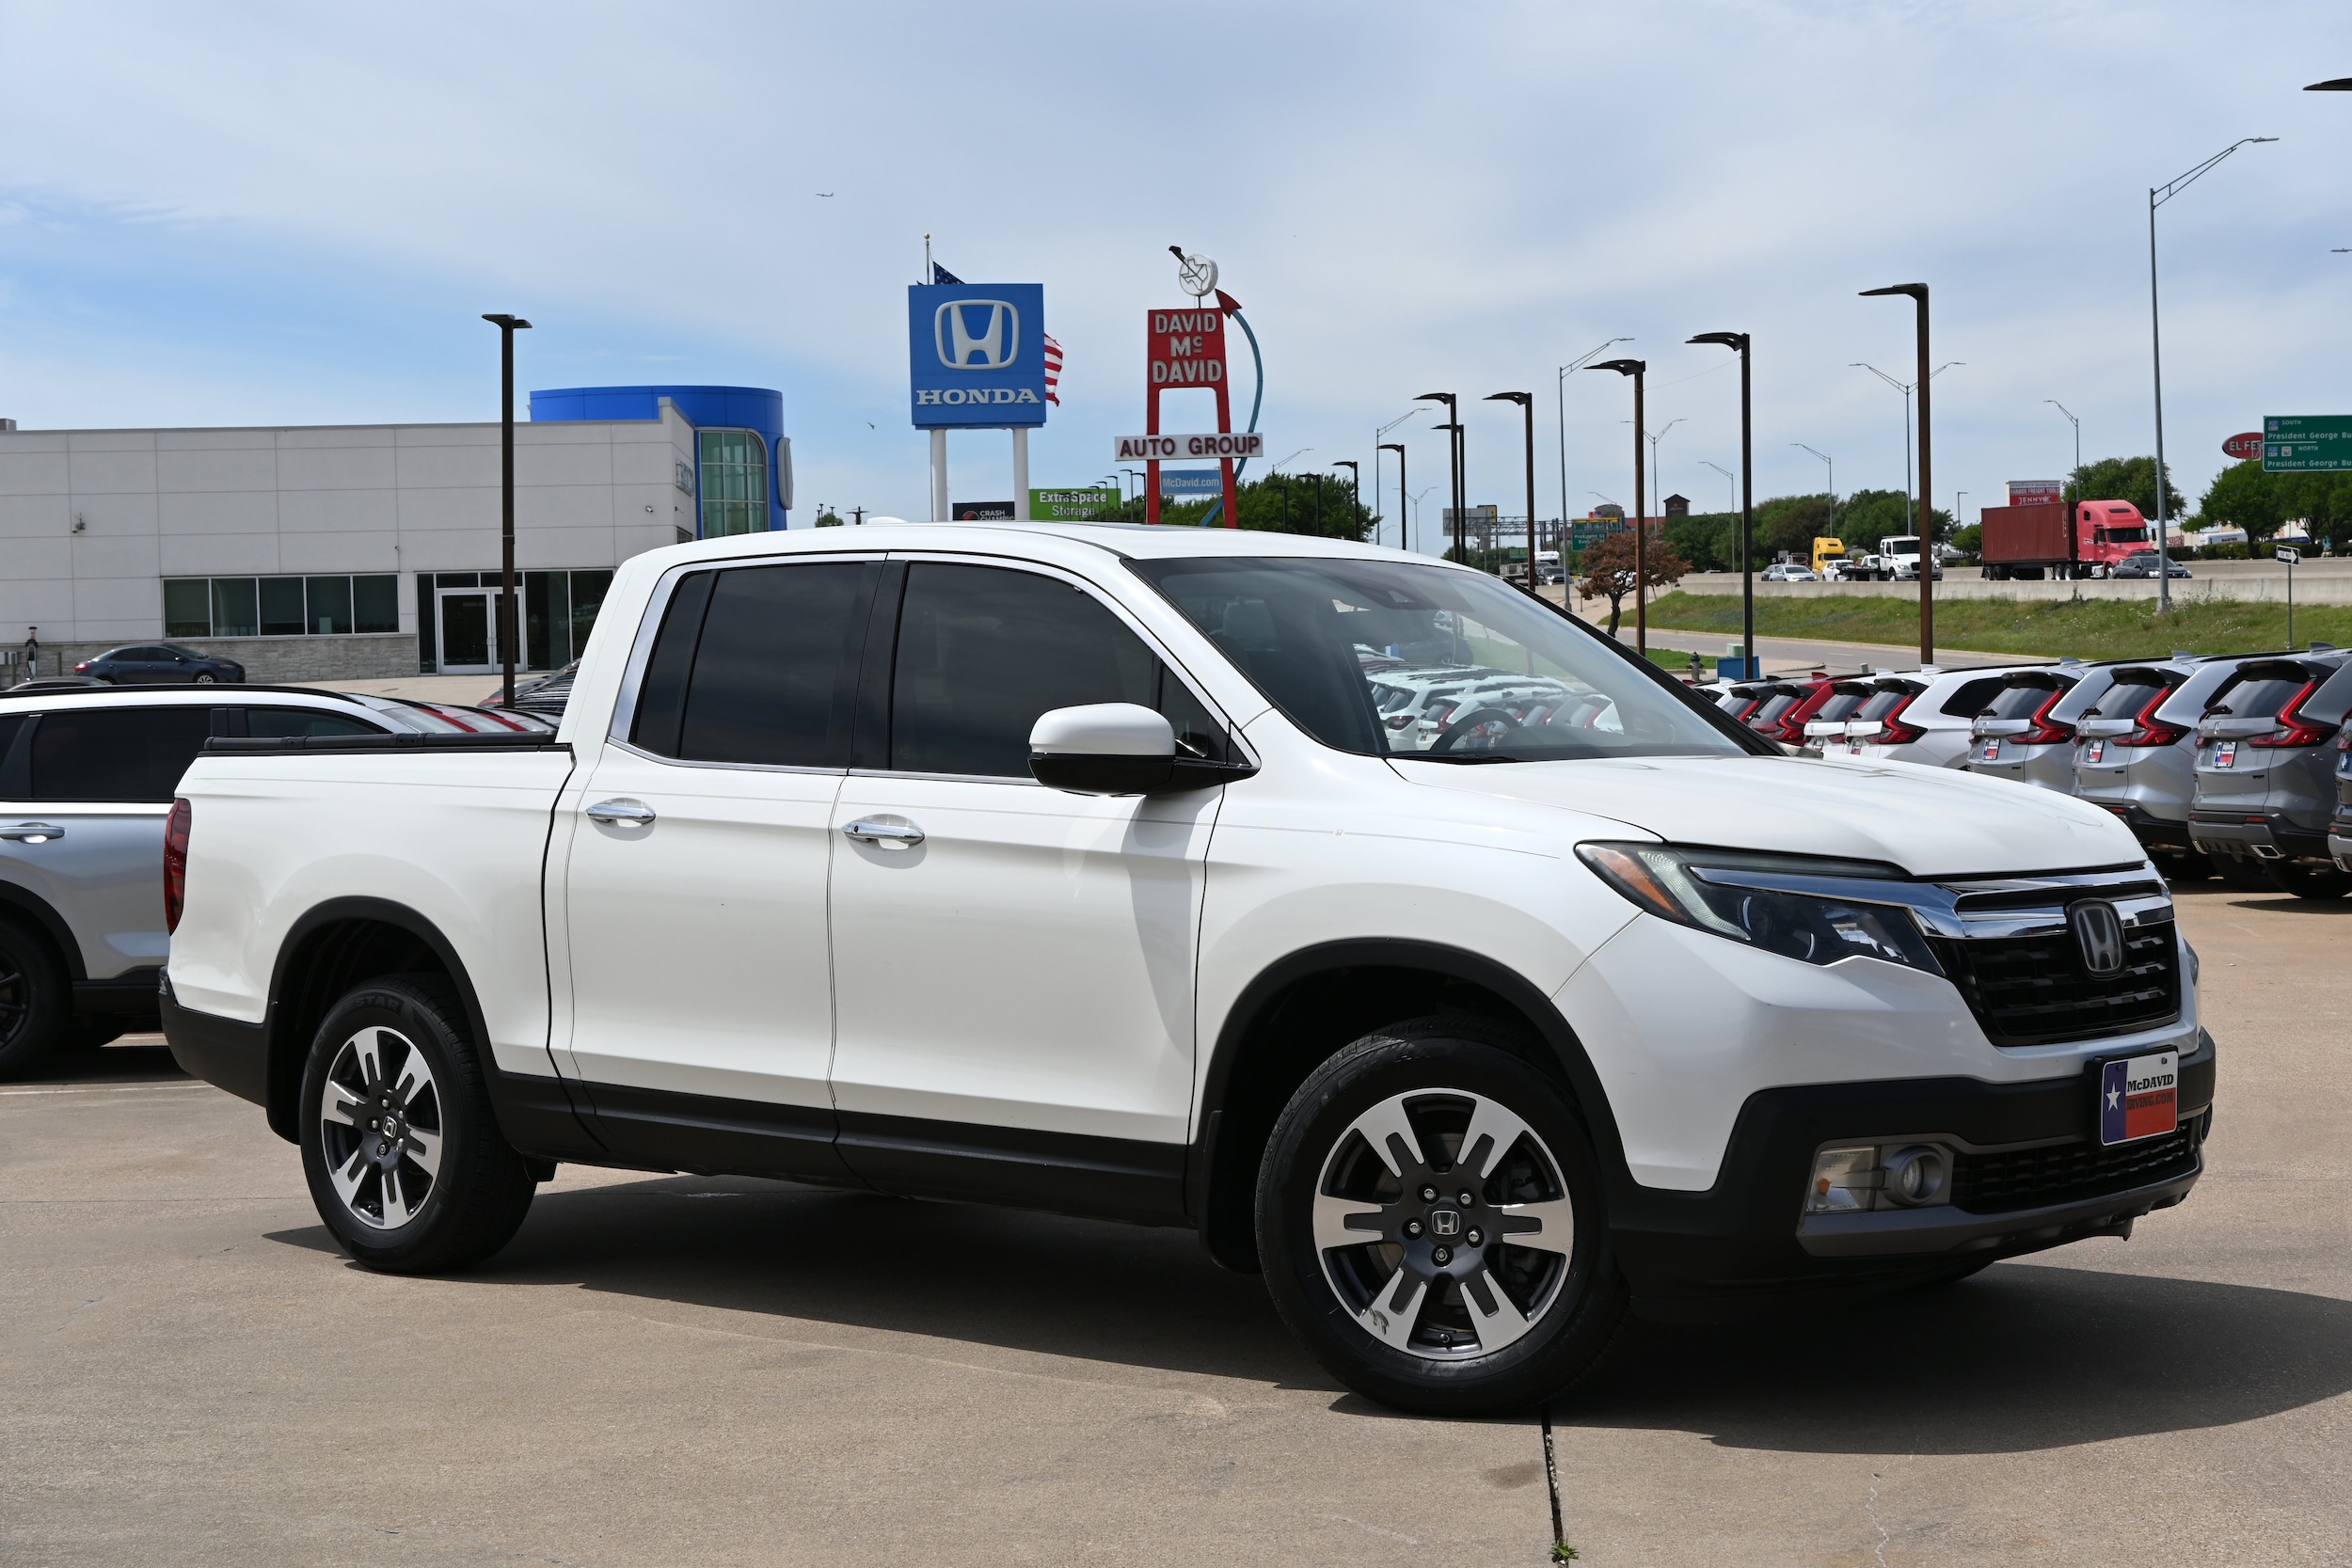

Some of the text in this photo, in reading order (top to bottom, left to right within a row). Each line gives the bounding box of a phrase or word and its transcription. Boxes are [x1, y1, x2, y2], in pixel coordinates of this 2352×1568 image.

[1154, 312, 1217, 334] DAVID
[1169, 335, 1203, 357] Mc
[1152, 359, 1223, 384] DAVID
[915, 388, 1041, 405] HONDA
[1120, 436, 1260, 457] AUTO GROUP
[2229, 441, 2242, 451] EL
[2267, 459, 2306, 467] President
[2309, 460, 2338, 468] George
[1162, 477, 1219, 487] McDavid.com
[1039, 490, 1107, 505] Extra Space
[1052, 505, 1095, 518] Storage
[2126, 1073, 2174, 1093] McDAVID
[2126, 1091, 2174, 1110] IRVING.COM
